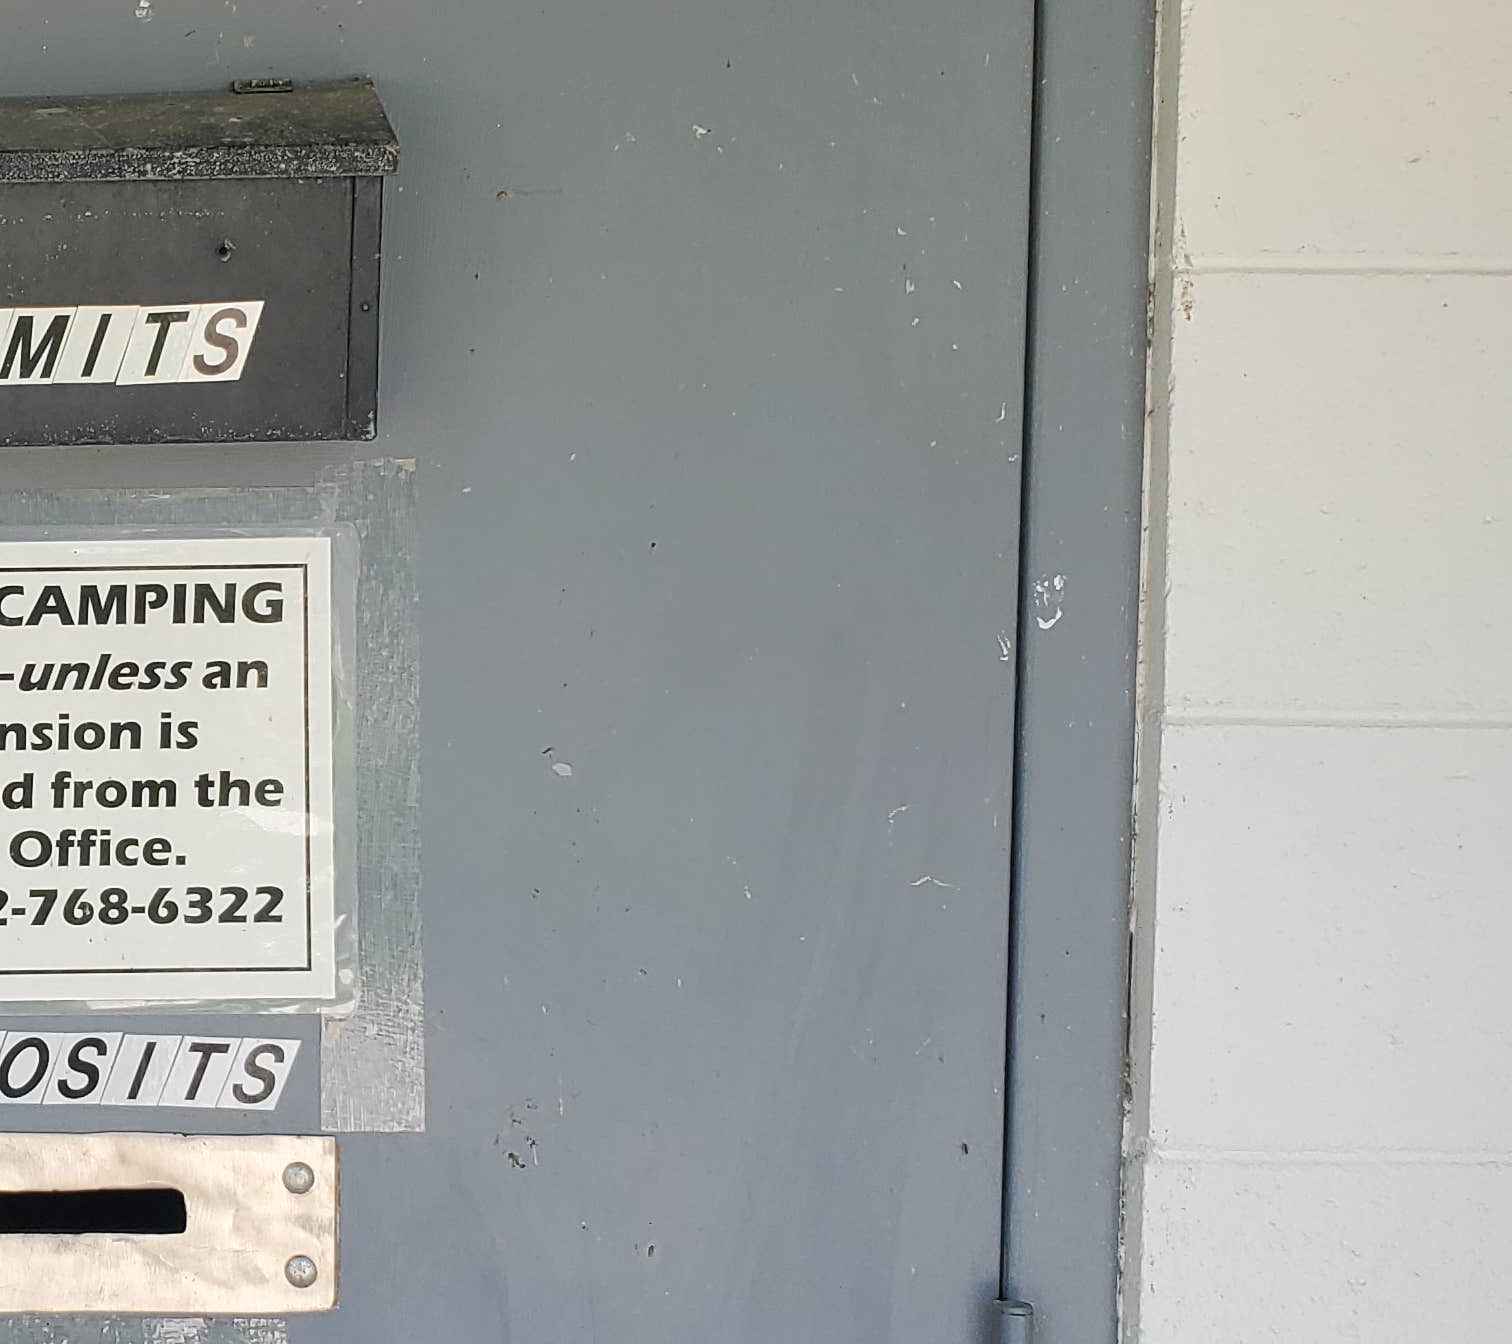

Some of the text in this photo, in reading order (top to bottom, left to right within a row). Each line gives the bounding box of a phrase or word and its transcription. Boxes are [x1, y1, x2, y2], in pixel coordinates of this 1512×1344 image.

[202, 661, 268, 689] an
[160, 712, 198, 749] is
[51, 771, 176, 808] from
[194, 771, 283, 807] the
[10, 829, 186, 867] Office.
